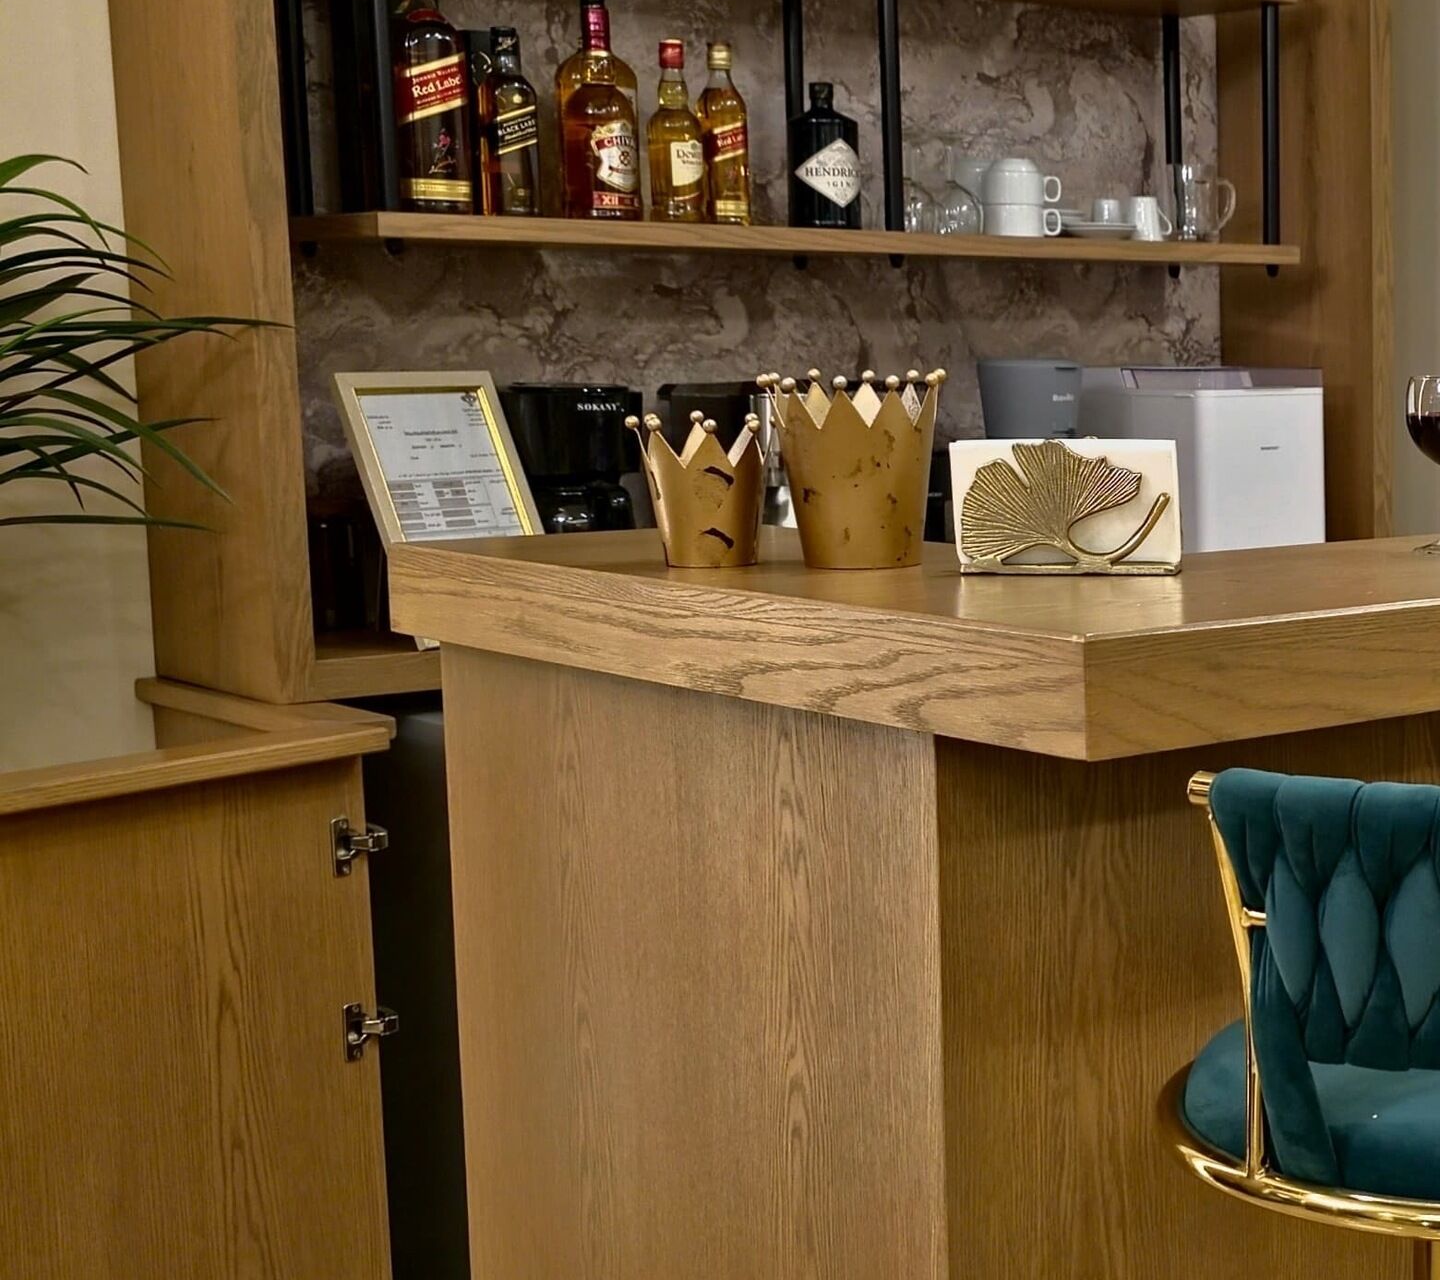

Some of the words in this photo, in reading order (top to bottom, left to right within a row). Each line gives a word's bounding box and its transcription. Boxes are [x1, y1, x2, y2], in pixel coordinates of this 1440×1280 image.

[411, 83, 437, 99] Red
[497, 124, 519, 137] BLACK
[576, 403, 618, 412] SOKANY
